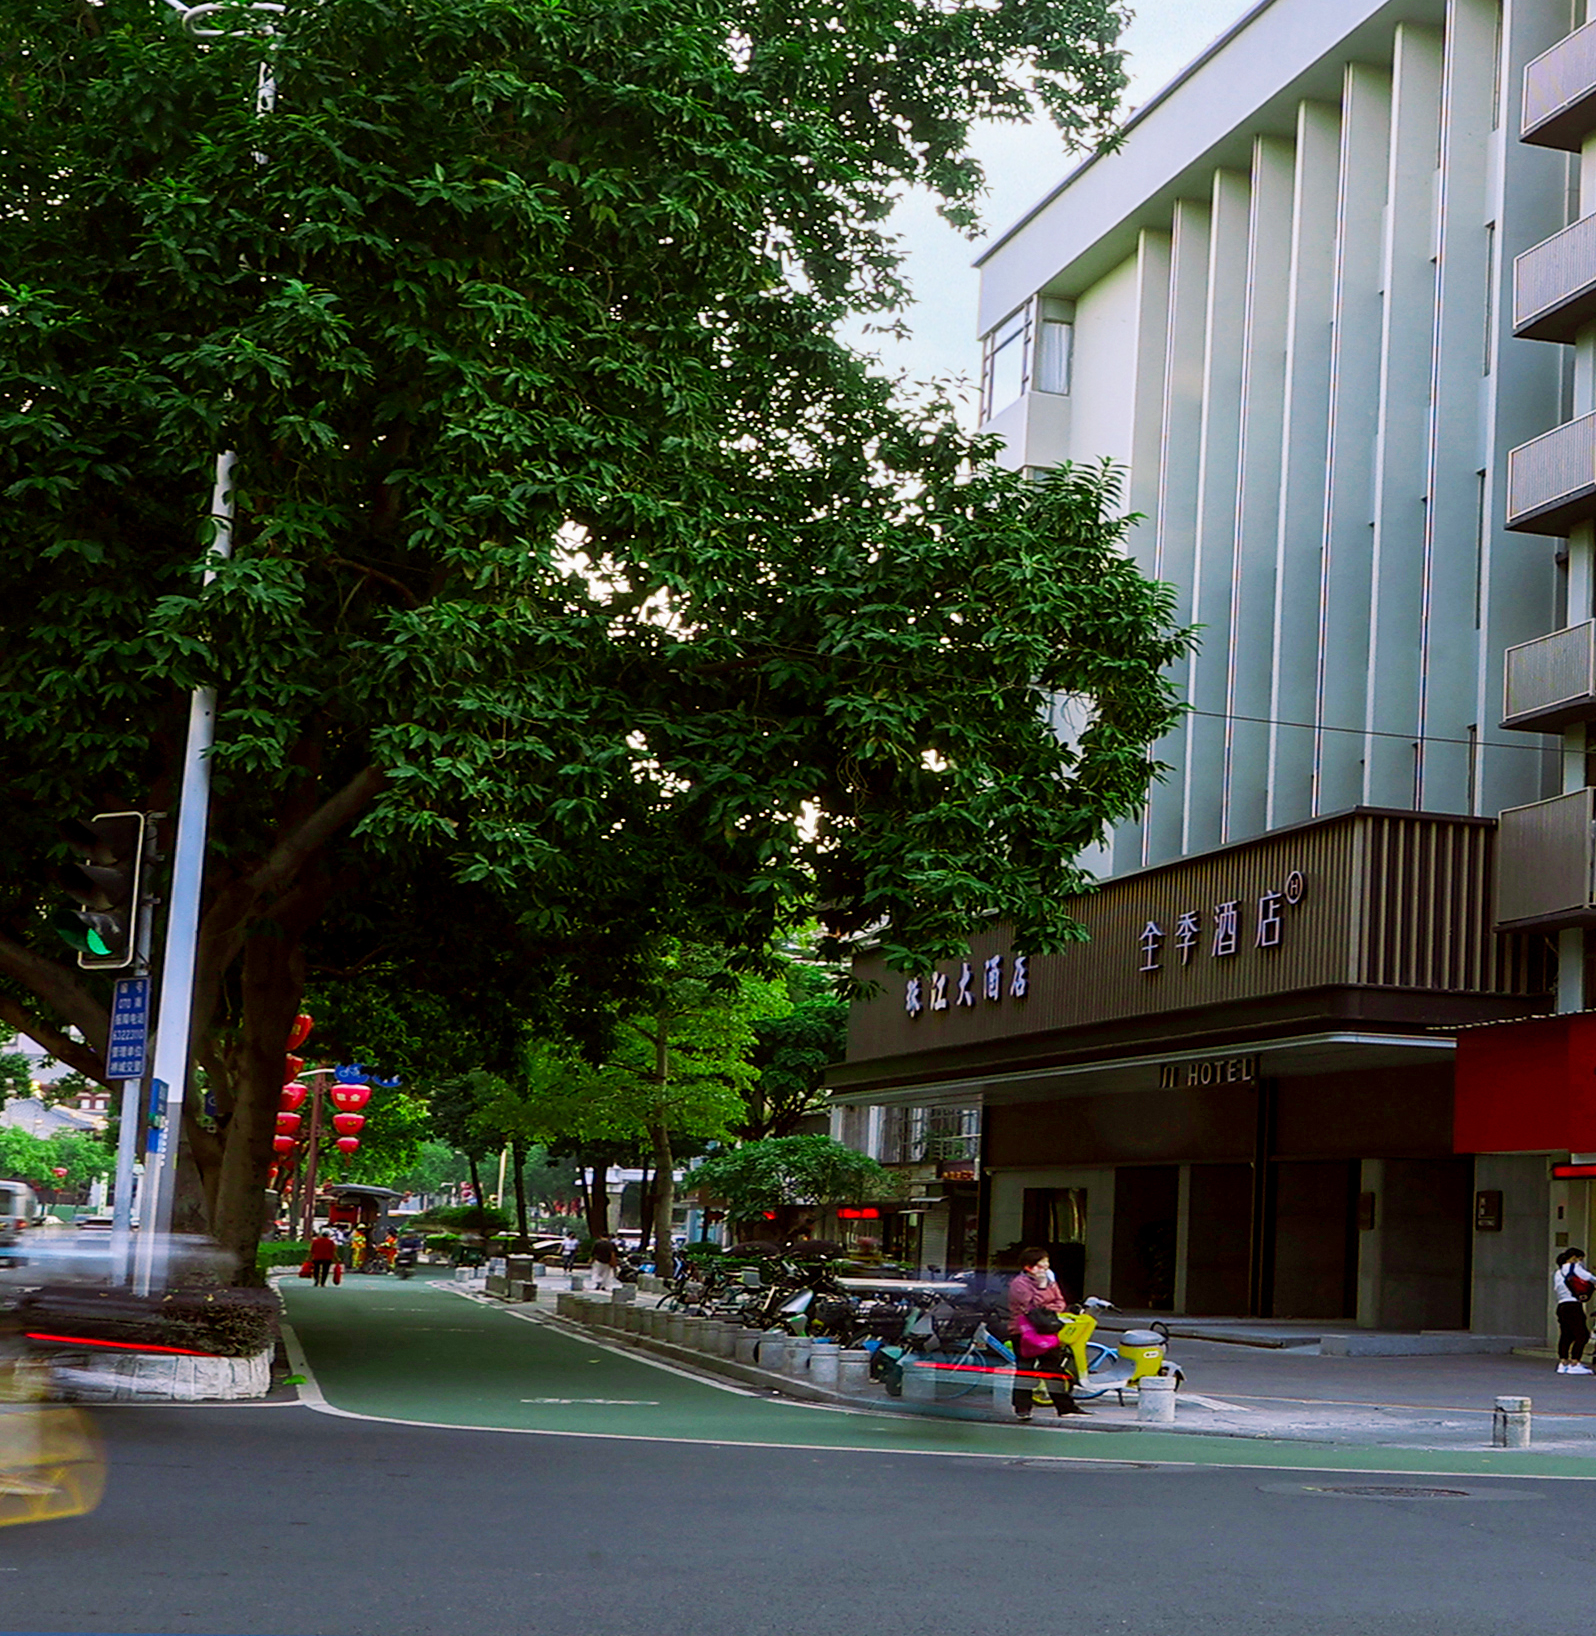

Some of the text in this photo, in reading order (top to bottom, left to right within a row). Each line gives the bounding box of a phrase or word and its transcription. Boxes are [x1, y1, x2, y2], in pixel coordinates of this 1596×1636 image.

[1138, 889, 1284, 972] 全季酒店
[905, 952, 1027, 1018] 珠江大酒店
[1188, 1058, 1252, 1087] HOTEL
